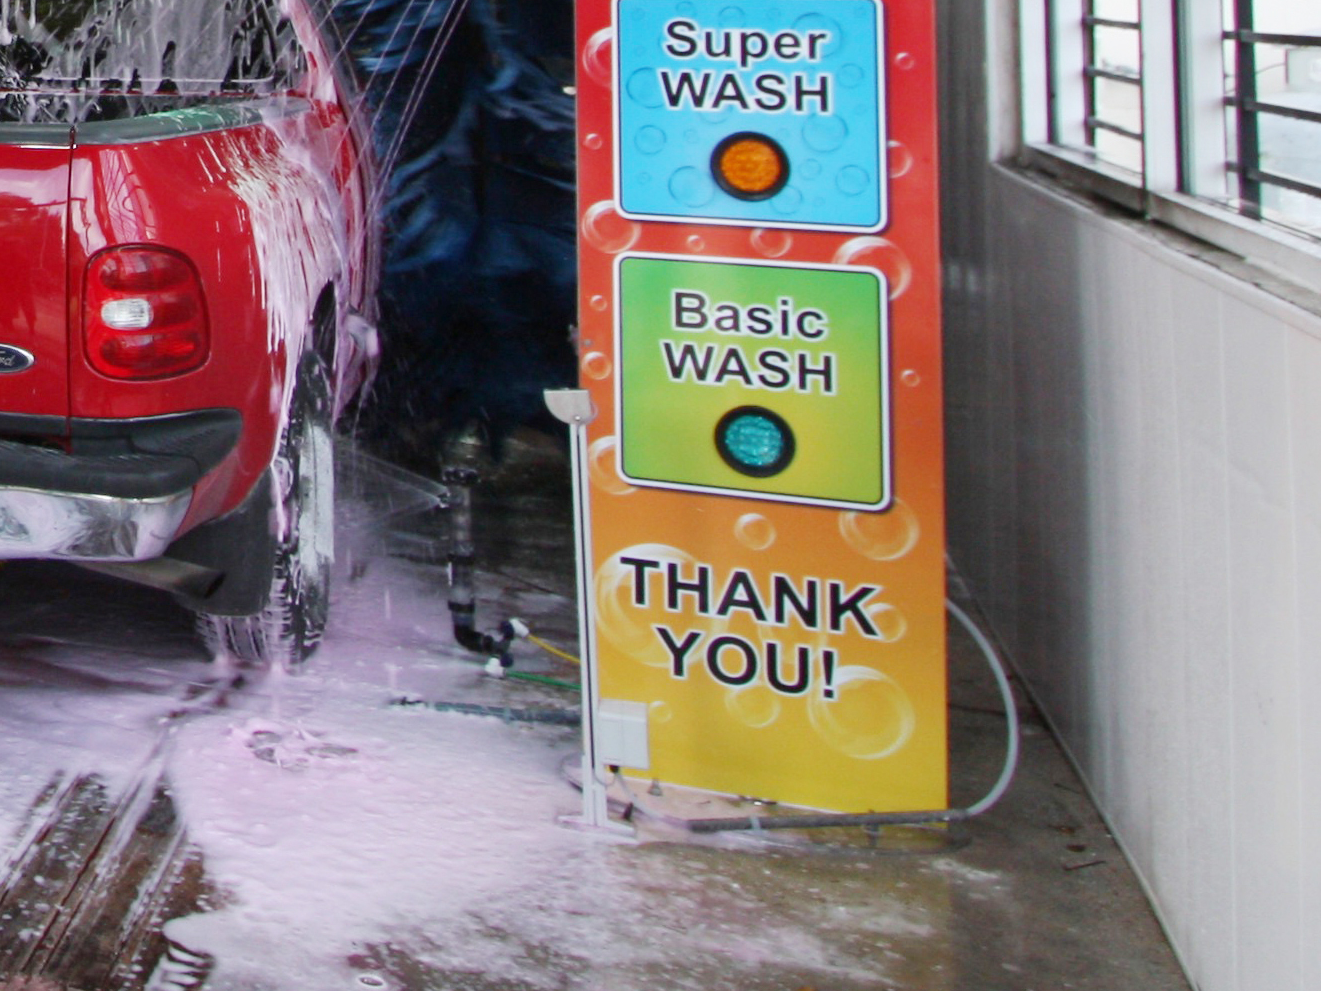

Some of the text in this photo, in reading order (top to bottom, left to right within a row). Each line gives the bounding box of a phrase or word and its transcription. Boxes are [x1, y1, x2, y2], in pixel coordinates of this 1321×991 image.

[665, 20, 828, 68] Super
[660, 71, 830, 113] WASH
[673, 291, 825, 340] Basic
[662, 341, 834, 393] WASH
[619, 556, 881, 638] THANK
[654, 626, 836, 700] YOU!
